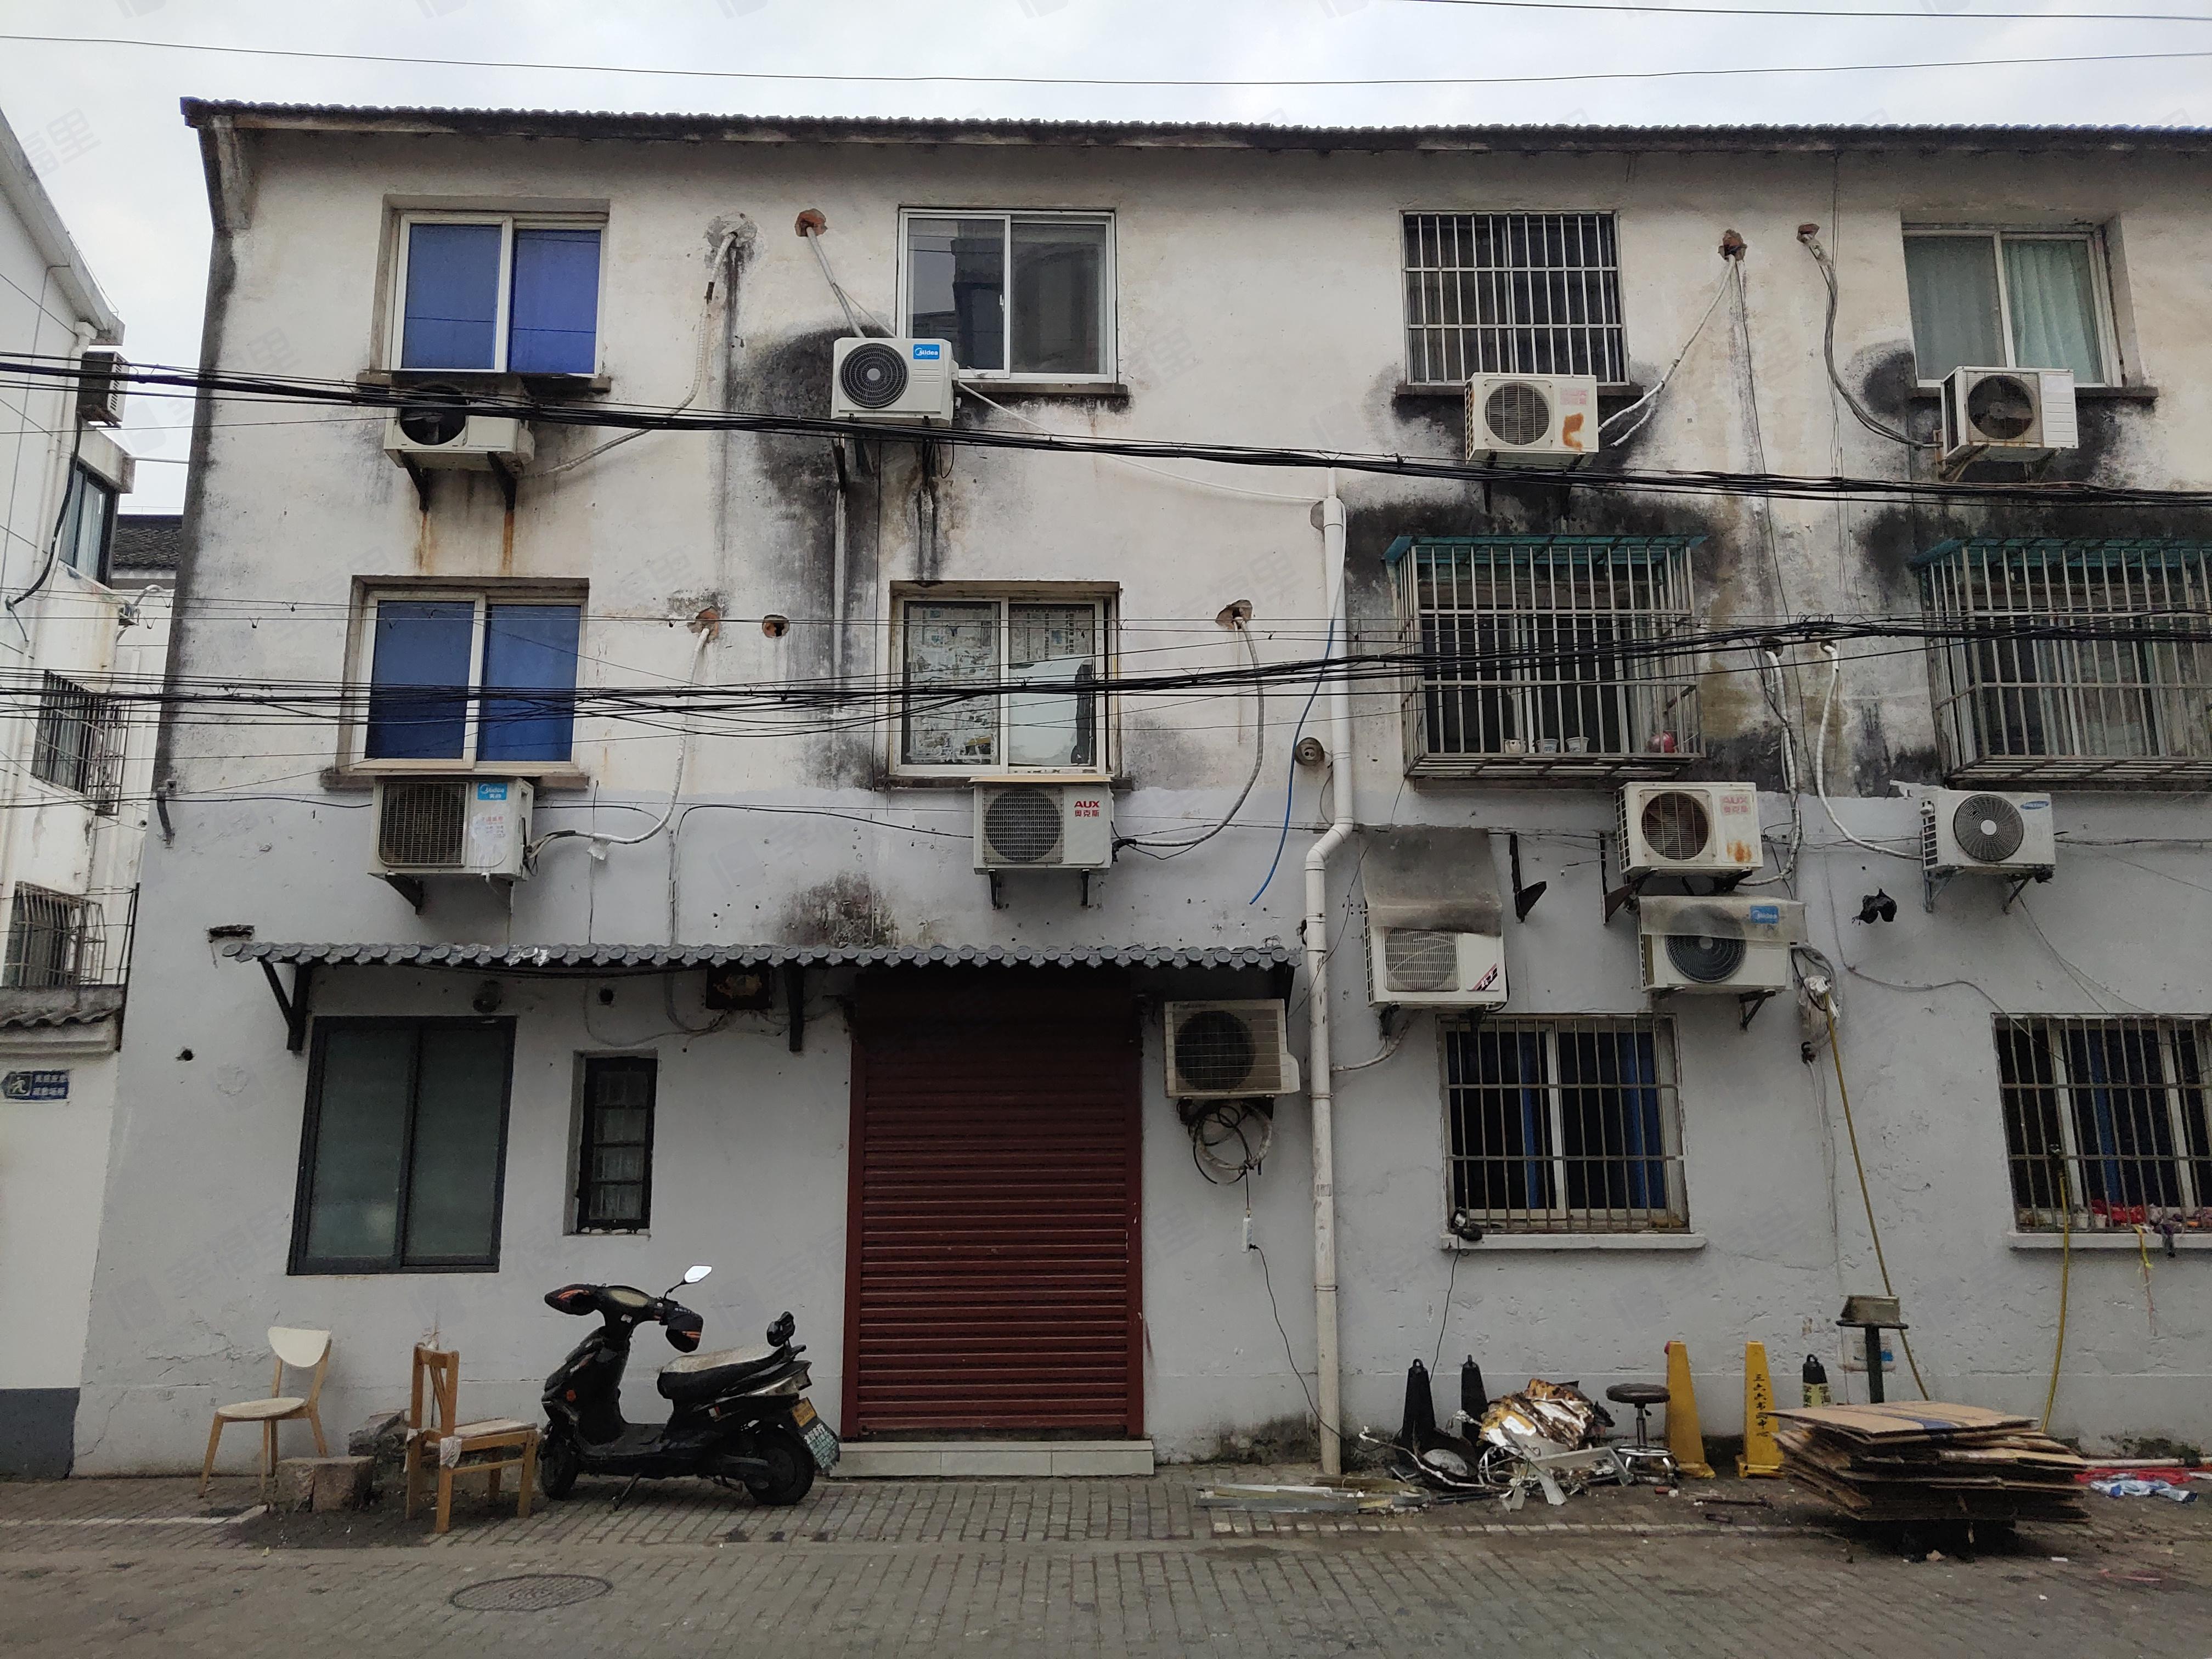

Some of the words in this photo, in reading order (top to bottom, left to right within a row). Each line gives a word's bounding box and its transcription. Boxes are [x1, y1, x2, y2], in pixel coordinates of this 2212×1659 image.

[915, 347, 938, 356] Midea
[480, 784, 504, 794] Midea
[1074, 809, 1100, 817] 奥克斯
